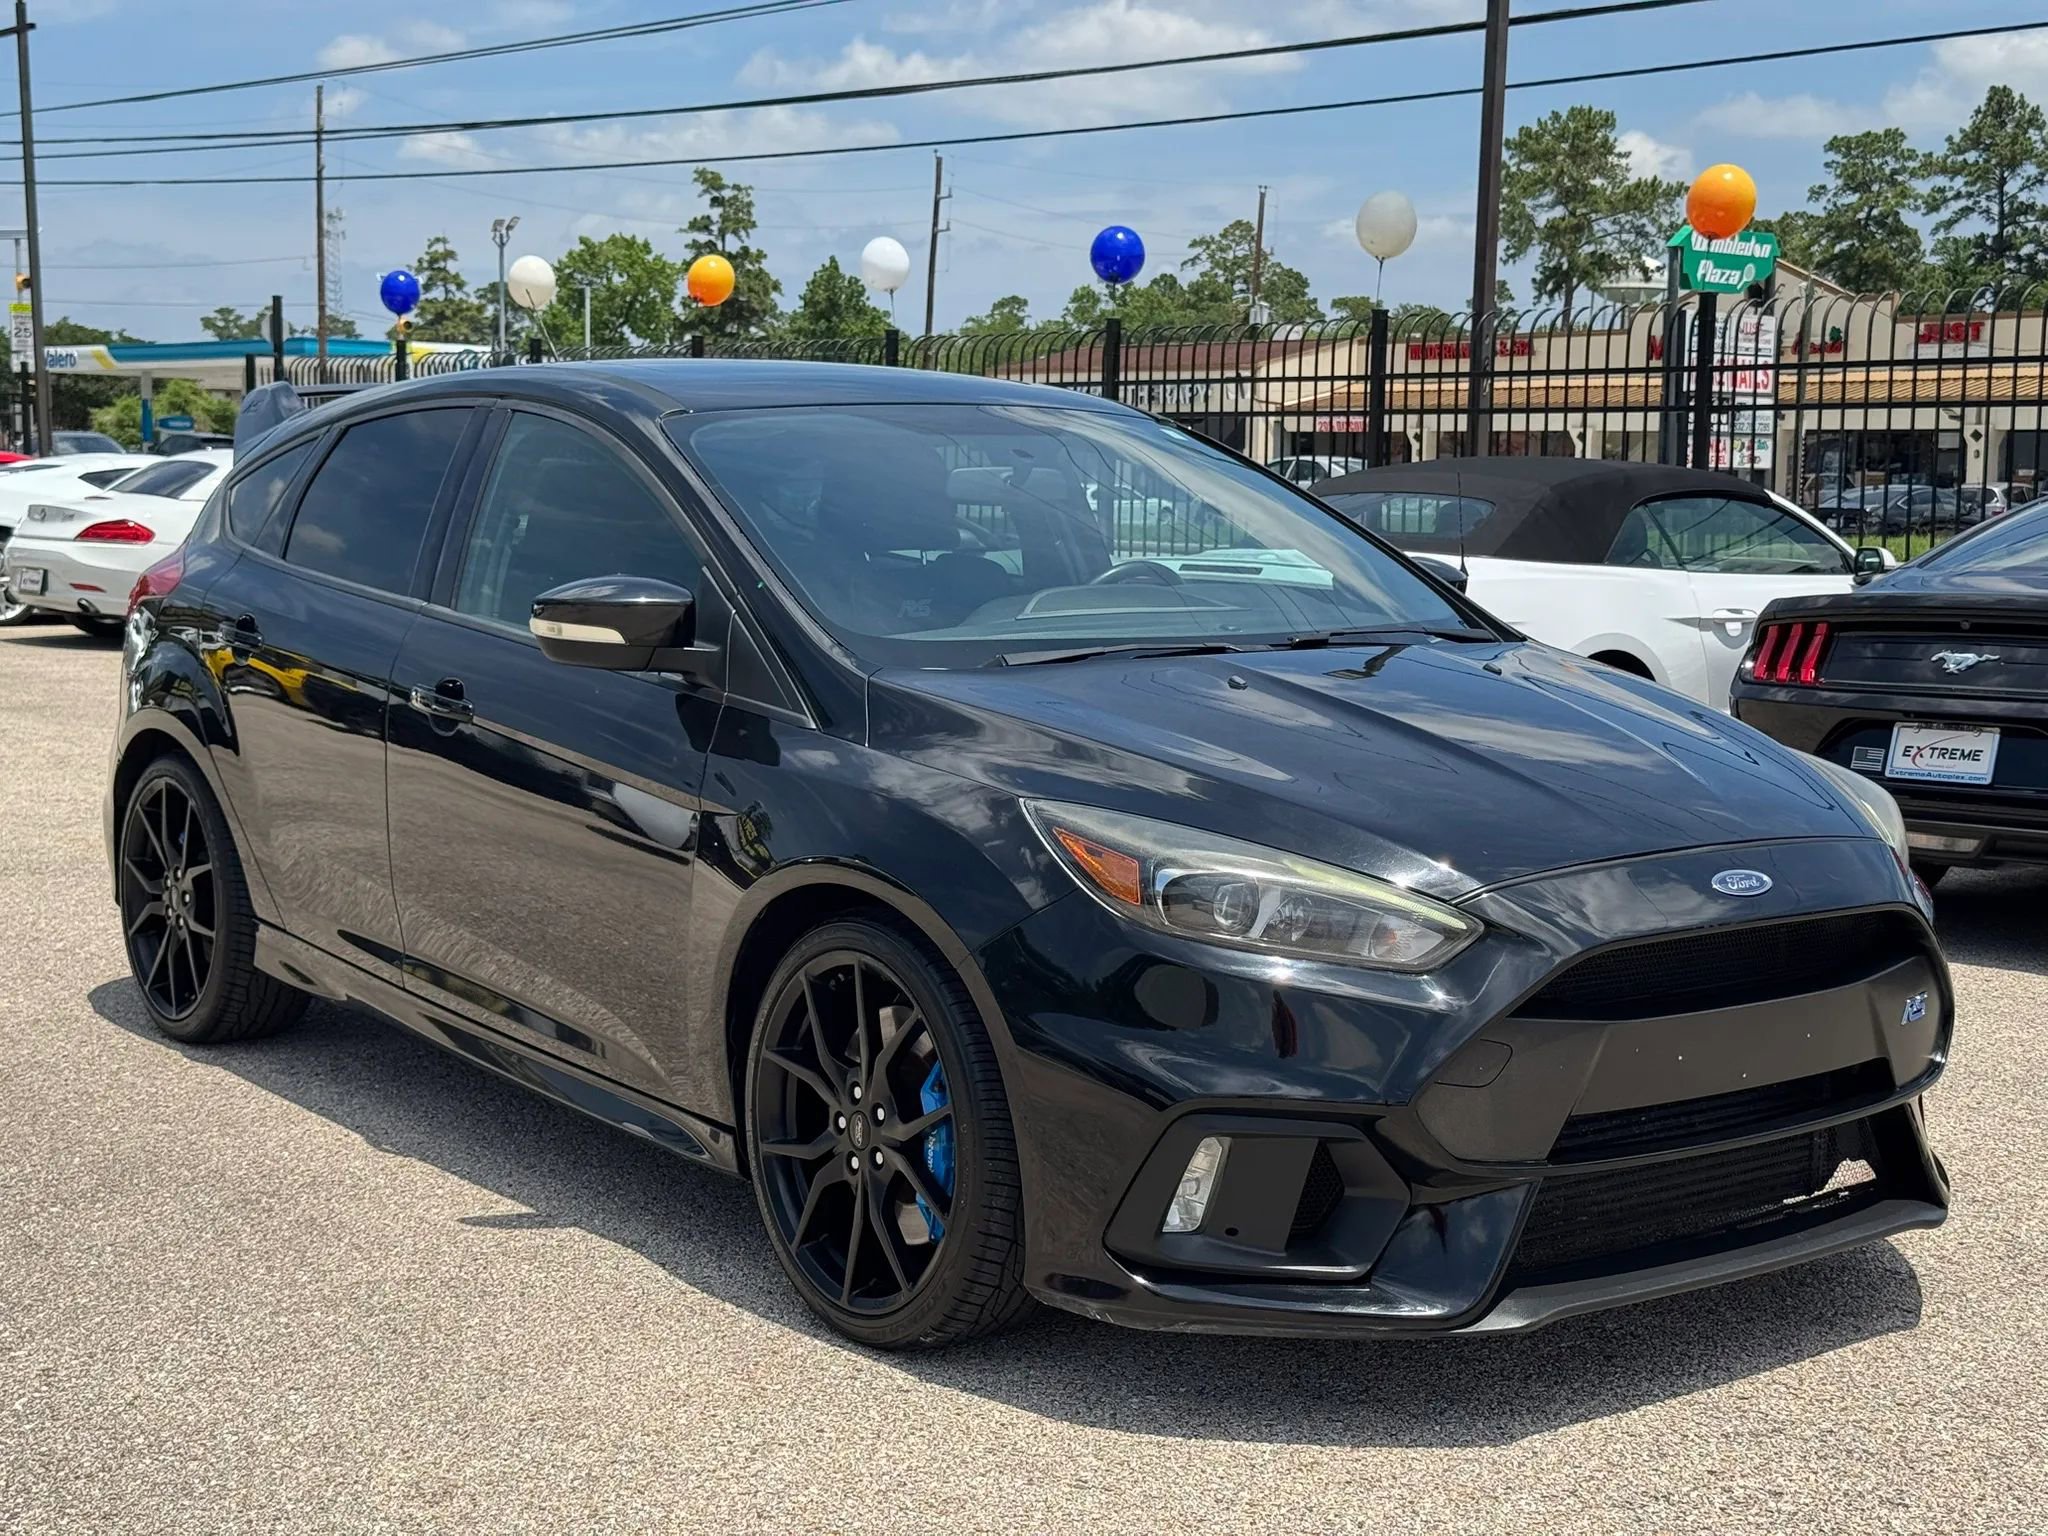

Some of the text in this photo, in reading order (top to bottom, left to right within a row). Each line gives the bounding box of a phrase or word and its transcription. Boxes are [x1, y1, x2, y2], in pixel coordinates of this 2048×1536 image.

[1697, 260, 1742, 285] Plaza
[14, 327, 32, 338] 25
[1917, 322, 1985, 344] JUST
[1409, 343, 1457, 360] MDERN
[1902, 745, 1984, 762] EXTREME
[1888, 768, 1988, 783] ExtremeAutoplex.com
[1726, 874, 1760, 890] Ford
